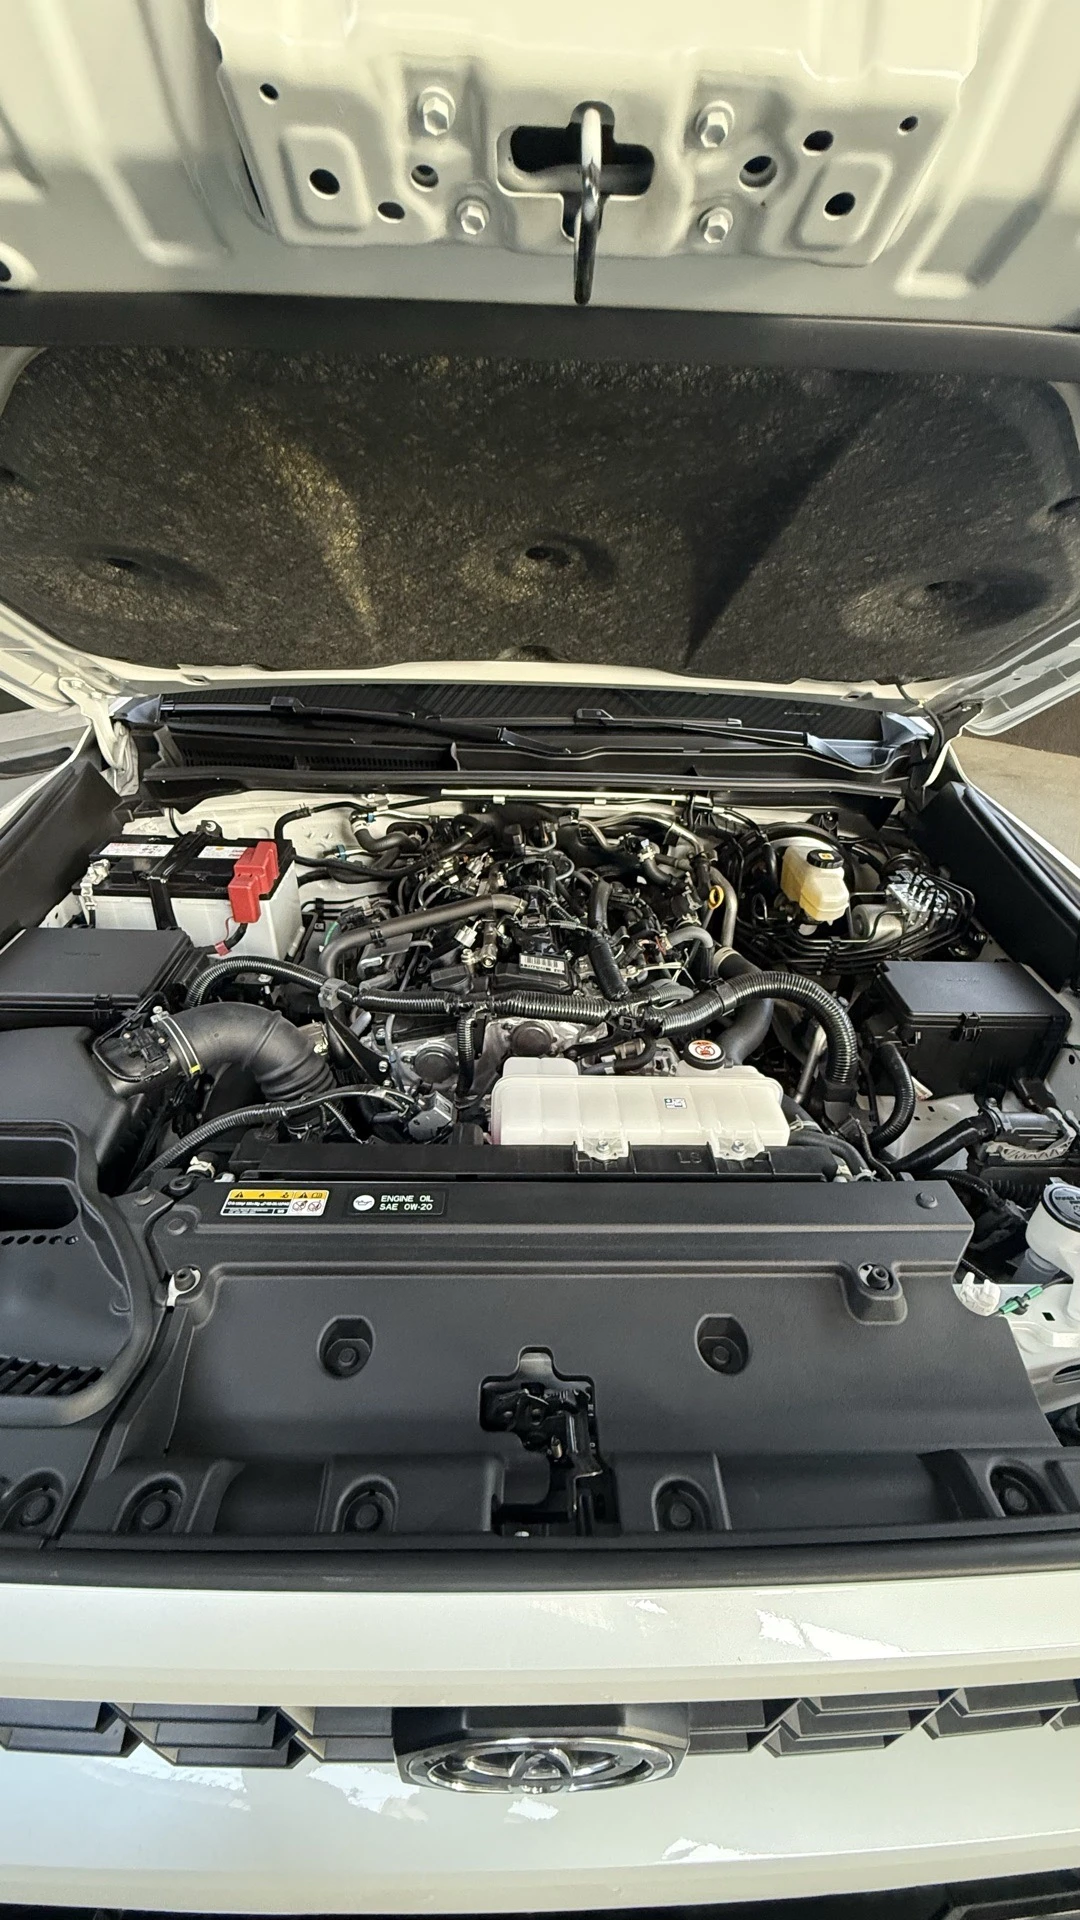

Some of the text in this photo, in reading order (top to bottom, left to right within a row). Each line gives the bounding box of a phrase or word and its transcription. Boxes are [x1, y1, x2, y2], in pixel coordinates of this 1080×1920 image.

[380, 1194, 435, 1203] ENGINE OIL
[379, 1203, 433, 1211] SAE 0W-20
